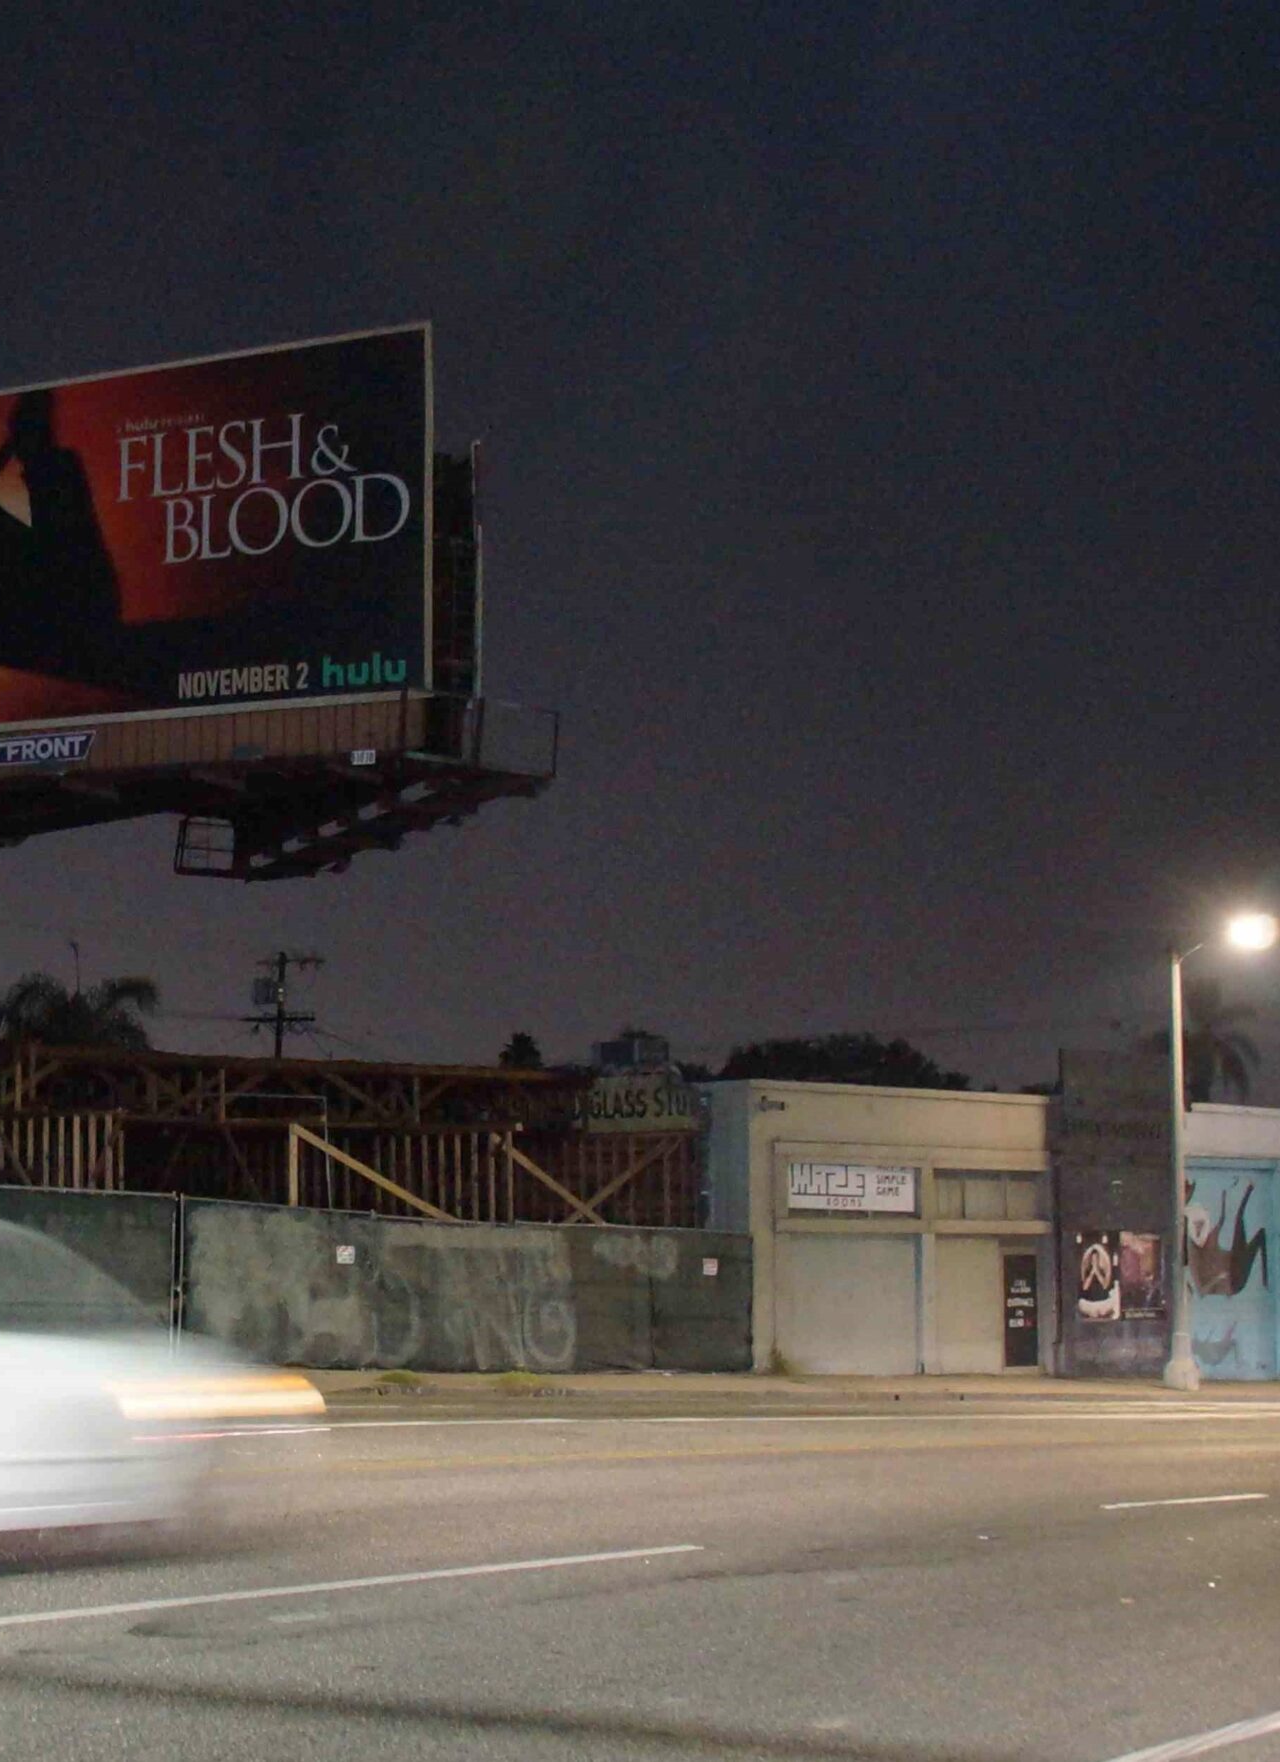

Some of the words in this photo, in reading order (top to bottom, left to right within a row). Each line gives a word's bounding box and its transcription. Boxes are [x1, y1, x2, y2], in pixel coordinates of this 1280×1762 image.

[116, 413, 305, 502] FLESH
[312, 425, 358, 475] &
[162, 473, 410, 564] BLOOD
[178, 664, 290, 699] NOVEMBER
[296, 661, 309, 689] 2
[322, 652, 407, 688] hulu
[588, 1088, 648, 1119] GLASS
